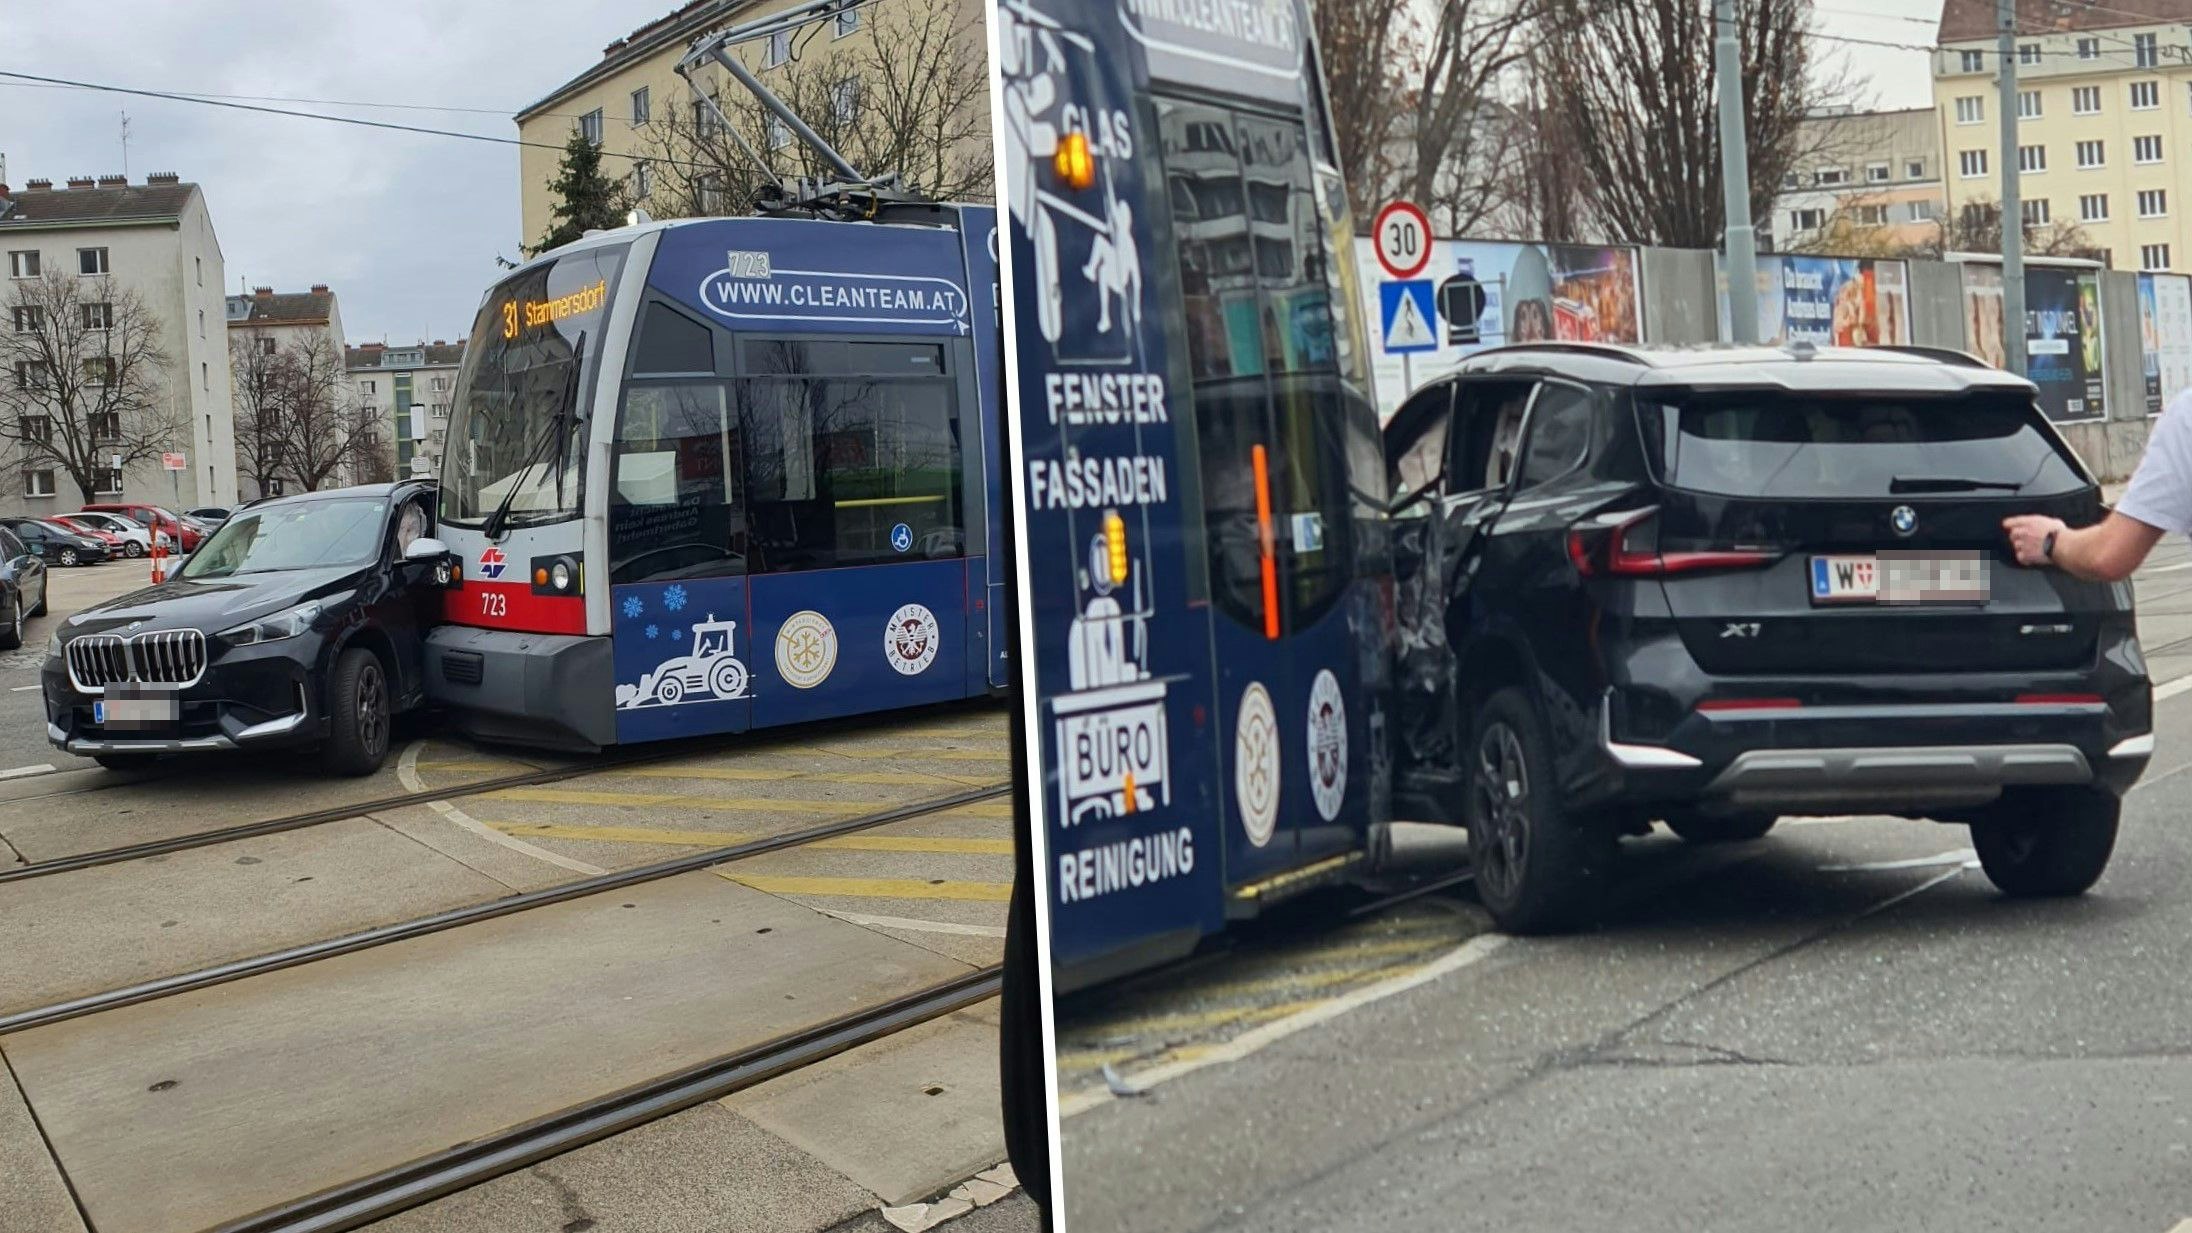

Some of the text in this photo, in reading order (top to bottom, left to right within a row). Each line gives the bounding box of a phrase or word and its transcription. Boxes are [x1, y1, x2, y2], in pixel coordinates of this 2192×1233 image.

[729, 252, 769, 277] 723
[1390, 223, 1416, 256] 30
[503, 279, 605, 338] 31 Stammersdorf
[716, 282, 955, 311] WWW.CLEANTEAM.AT
[1045, 373, 1168, 425] FENSTER
[1029, 455, 1167, 511] FASSADEN
[482, 592, 506, 616] 723
[888, 606, 935, 673] MEISTER BETRIEB
[1720, 623, 1760, 638] X1
[1077, 717, 1151, 781] BÜRO
[1060, 827, 1194, 904] REINIGUNG
